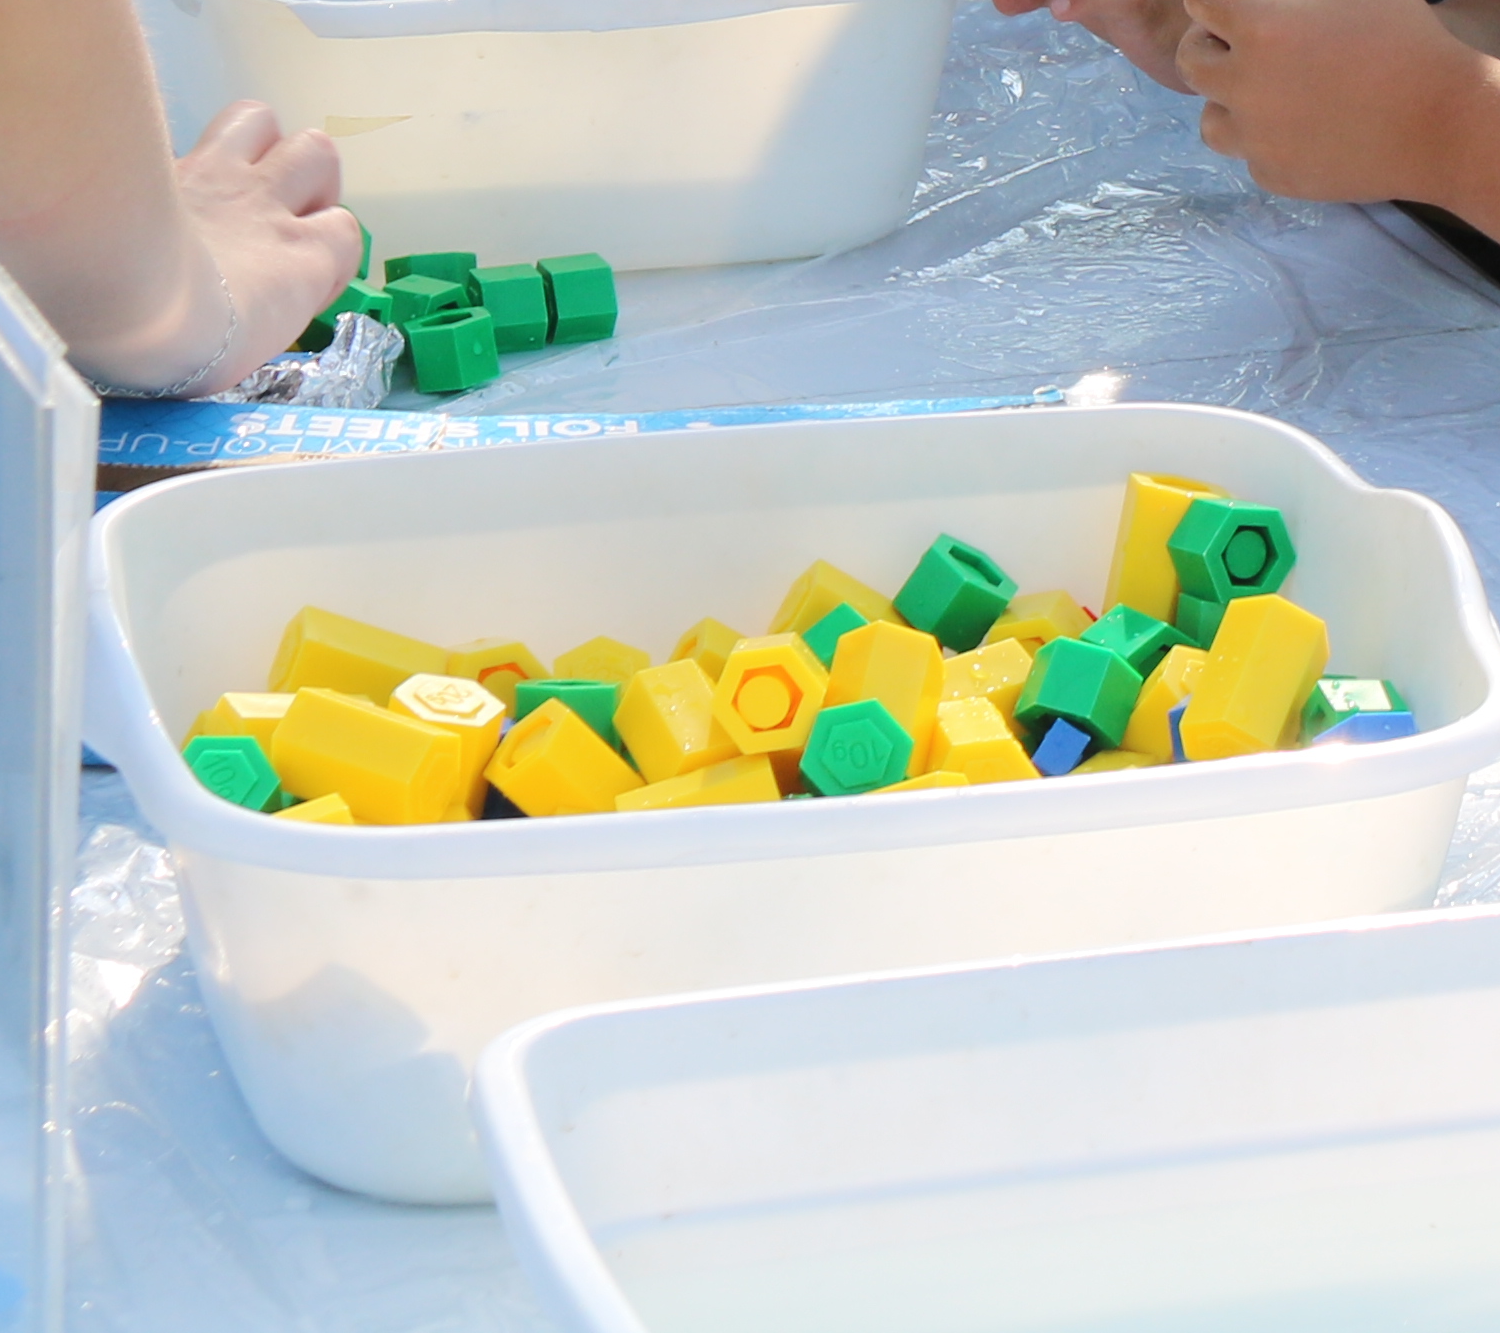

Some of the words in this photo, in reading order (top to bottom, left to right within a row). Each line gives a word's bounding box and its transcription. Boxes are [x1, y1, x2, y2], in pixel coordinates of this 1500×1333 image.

[228, 413, 481, 443] SHEETS
[497, 419, 639, 438] FOIL
[830, 738, 886, 771] 10g
